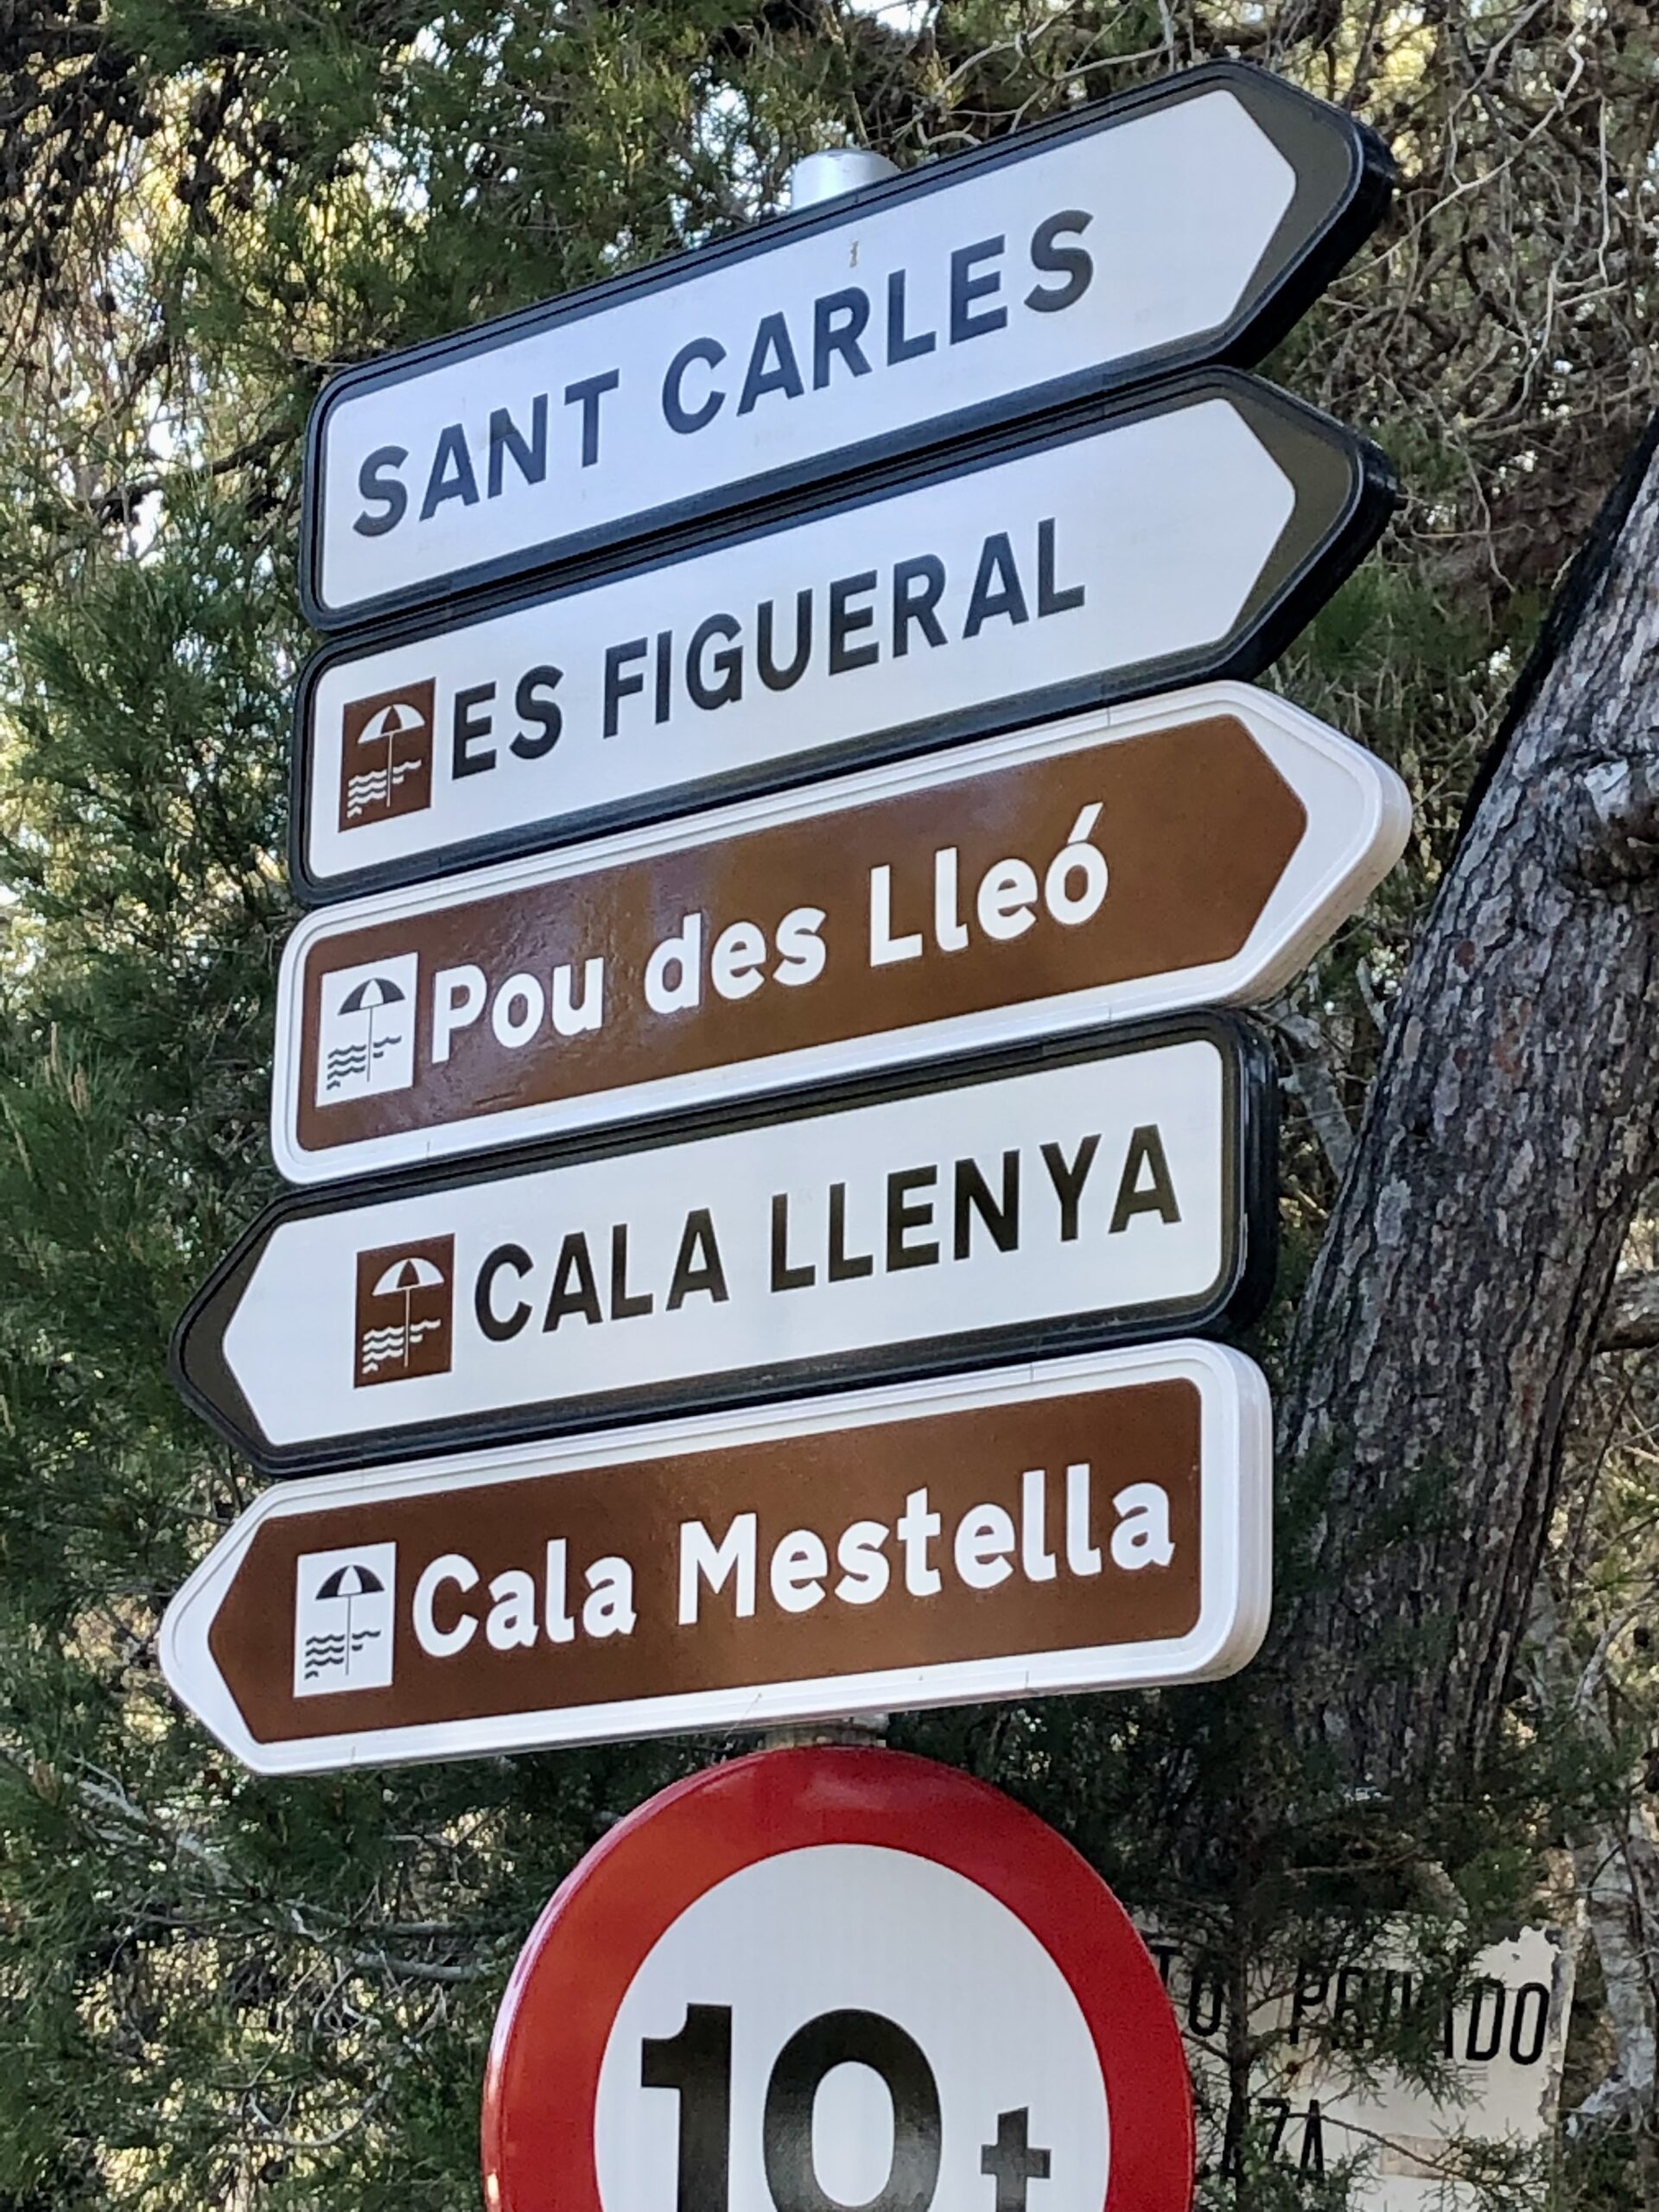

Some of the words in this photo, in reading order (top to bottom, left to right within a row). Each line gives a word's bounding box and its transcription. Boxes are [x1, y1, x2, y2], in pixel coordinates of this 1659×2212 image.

[353, 369, 620, 537] SANT
[662, 207, 1093, 435] CARLES
[451, 664, 563, 781] ES
[602, 518, 1085, 739] FIGUERAL
[431, 957, 604, 1064] Pou
[644, 907, 826, 1014] des
[870, 802, 1109, 968] Lleó
[474, 1208, 729, 1342] CALA
[771, 1124, 1181, 1294] LLENYA
[412, 1539, 637, 1657] Cala
[678, 1463, 1175, 1625] Mestella
[641, 2002, 943, 2212] 10
[981, 2107, 1051, 2212] t
